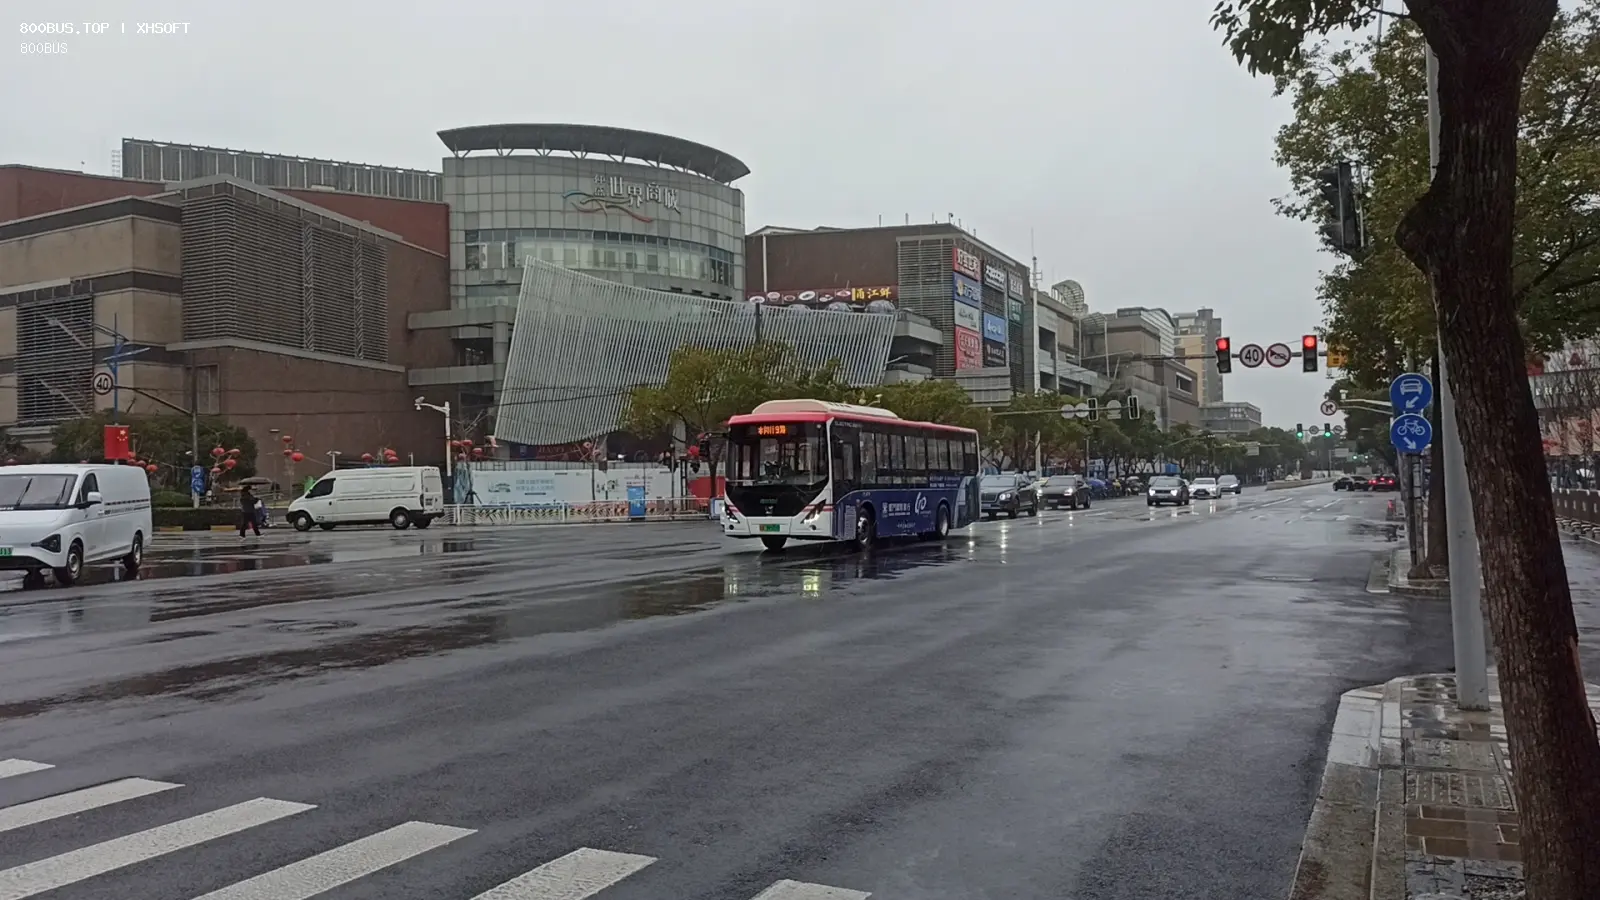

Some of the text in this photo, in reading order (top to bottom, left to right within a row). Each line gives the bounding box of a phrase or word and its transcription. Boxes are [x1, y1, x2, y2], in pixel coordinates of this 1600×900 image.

[609, 176, 680, 213] 世界商城
[1244, 349, 1259, 362] 40
[96, 377, 109, 390] 40
